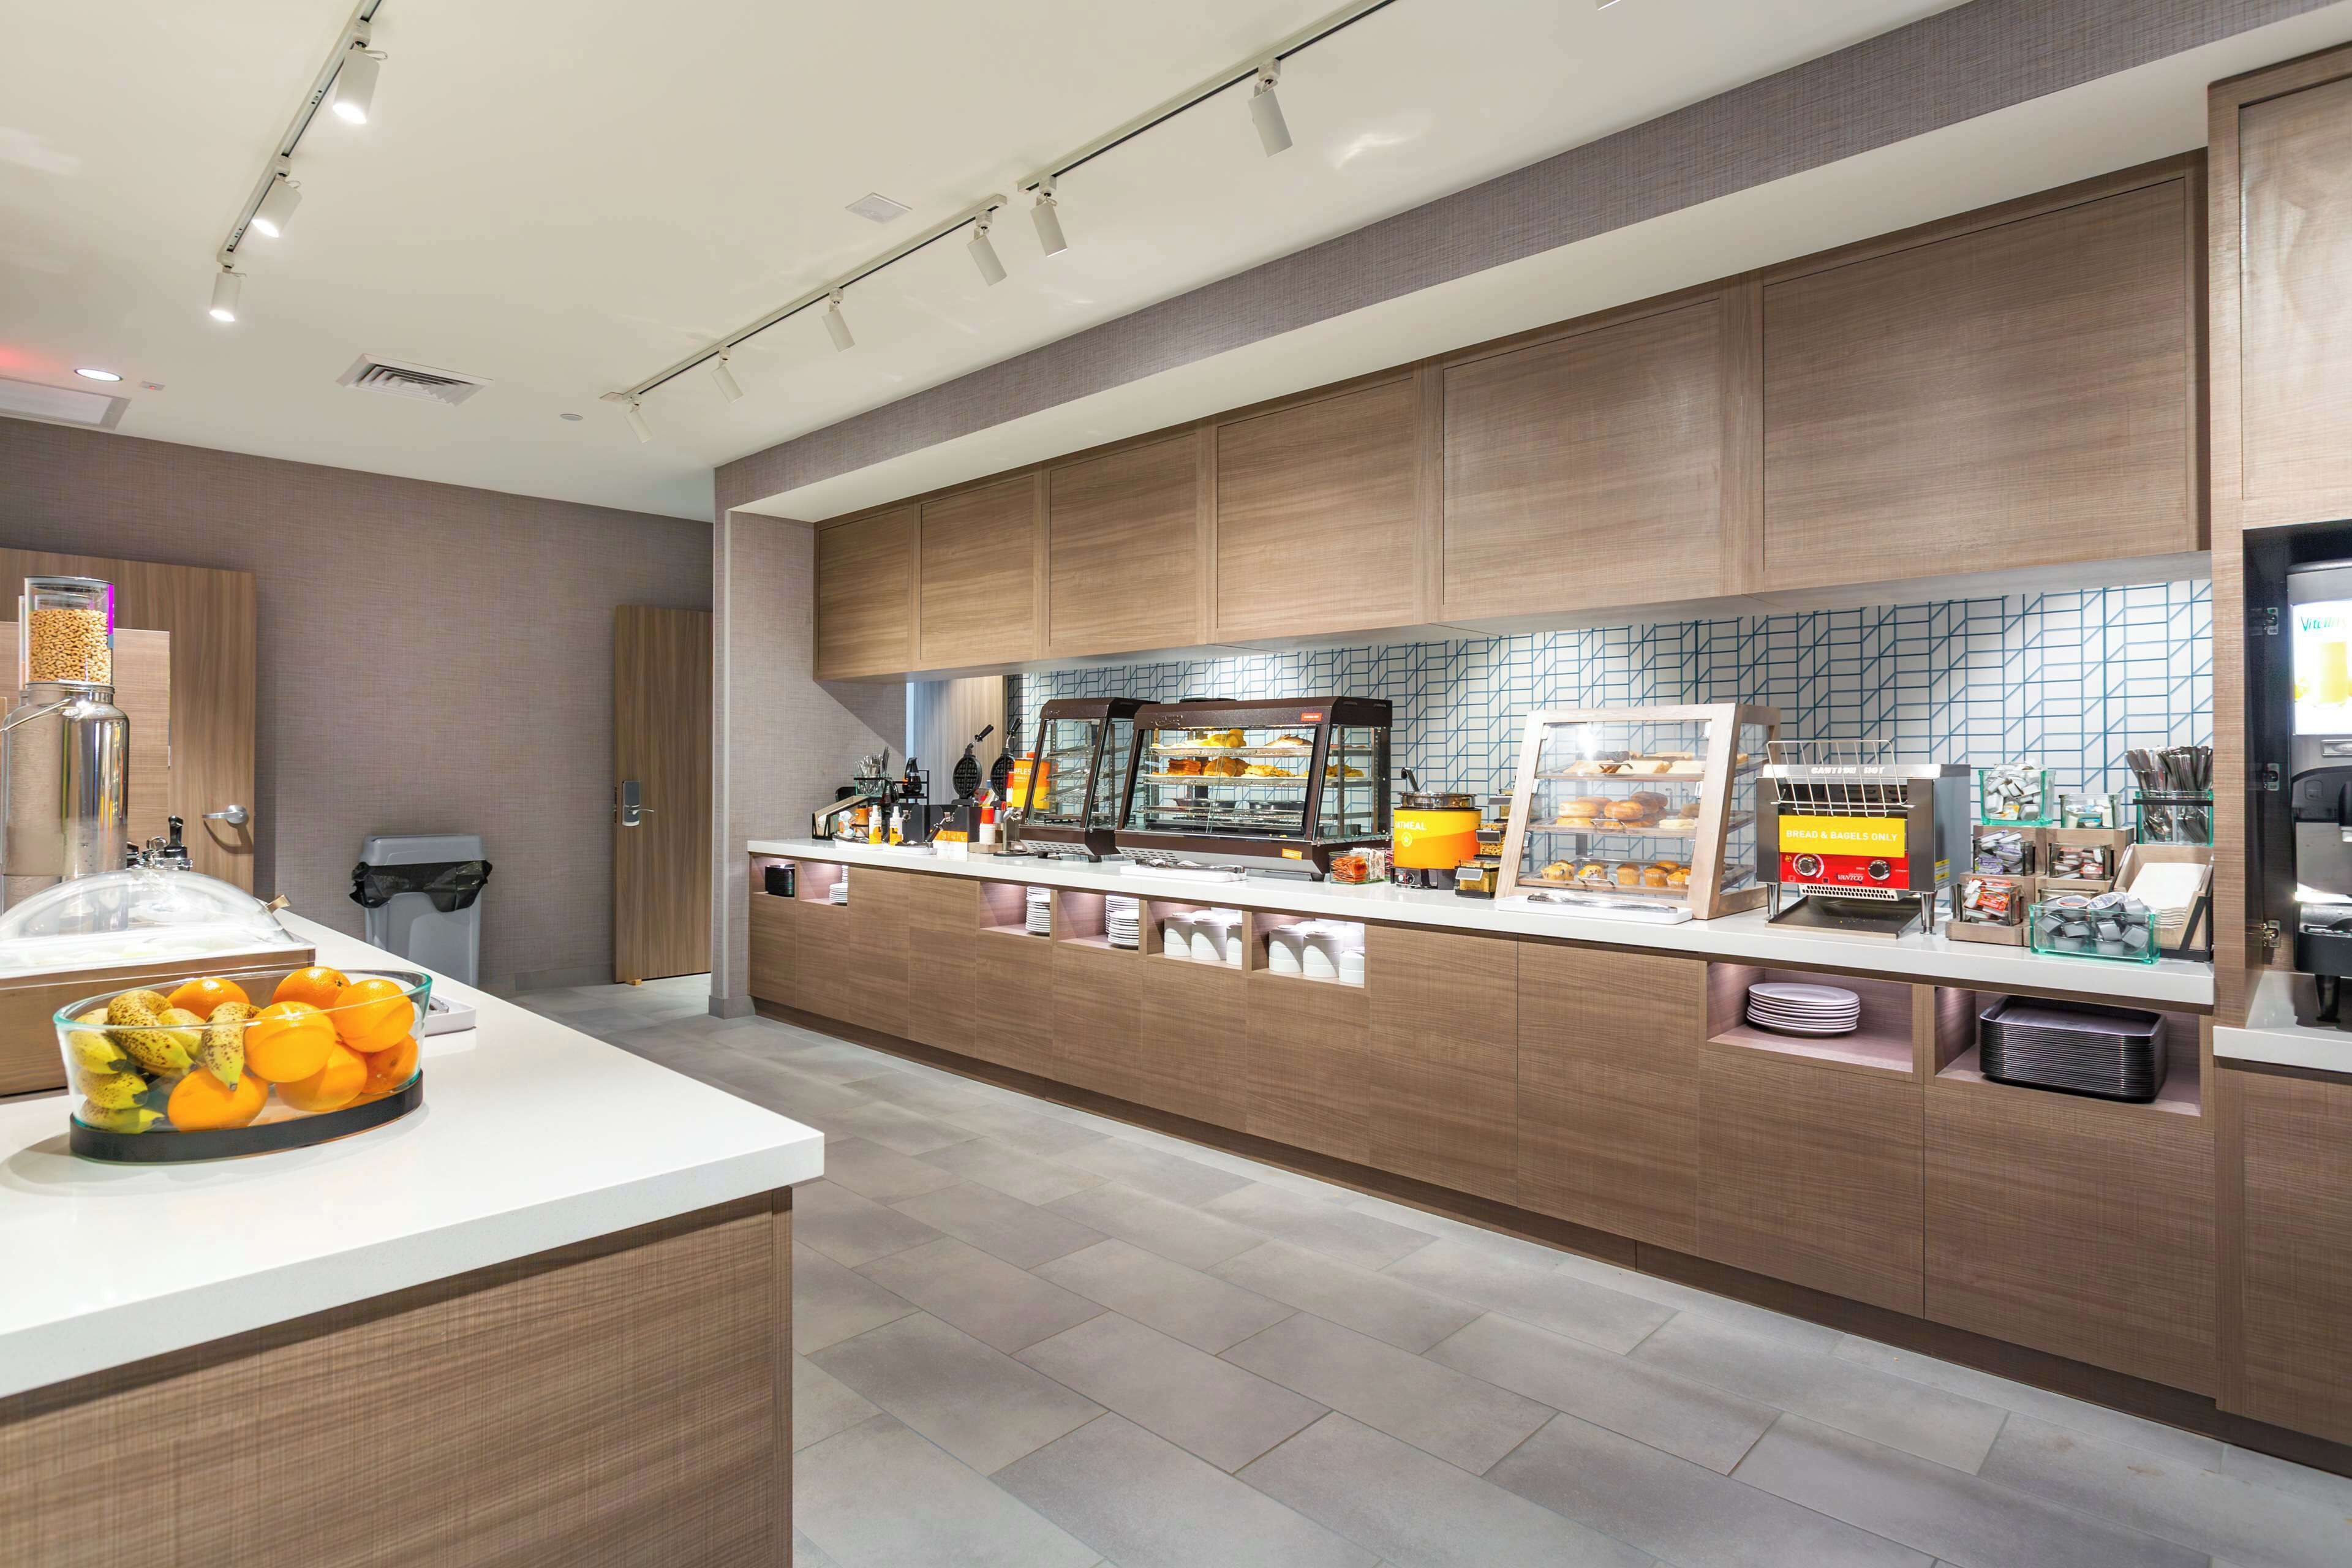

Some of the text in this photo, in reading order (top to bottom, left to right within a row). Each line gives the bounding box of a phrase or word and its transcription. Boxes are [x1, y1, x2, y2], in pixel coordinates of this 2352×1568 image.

[1786, 830, 1819, 839] BREAD
[1830, 831, 1868, 840] BAGELS
[1871, 833, 1898, 842] ONLY
